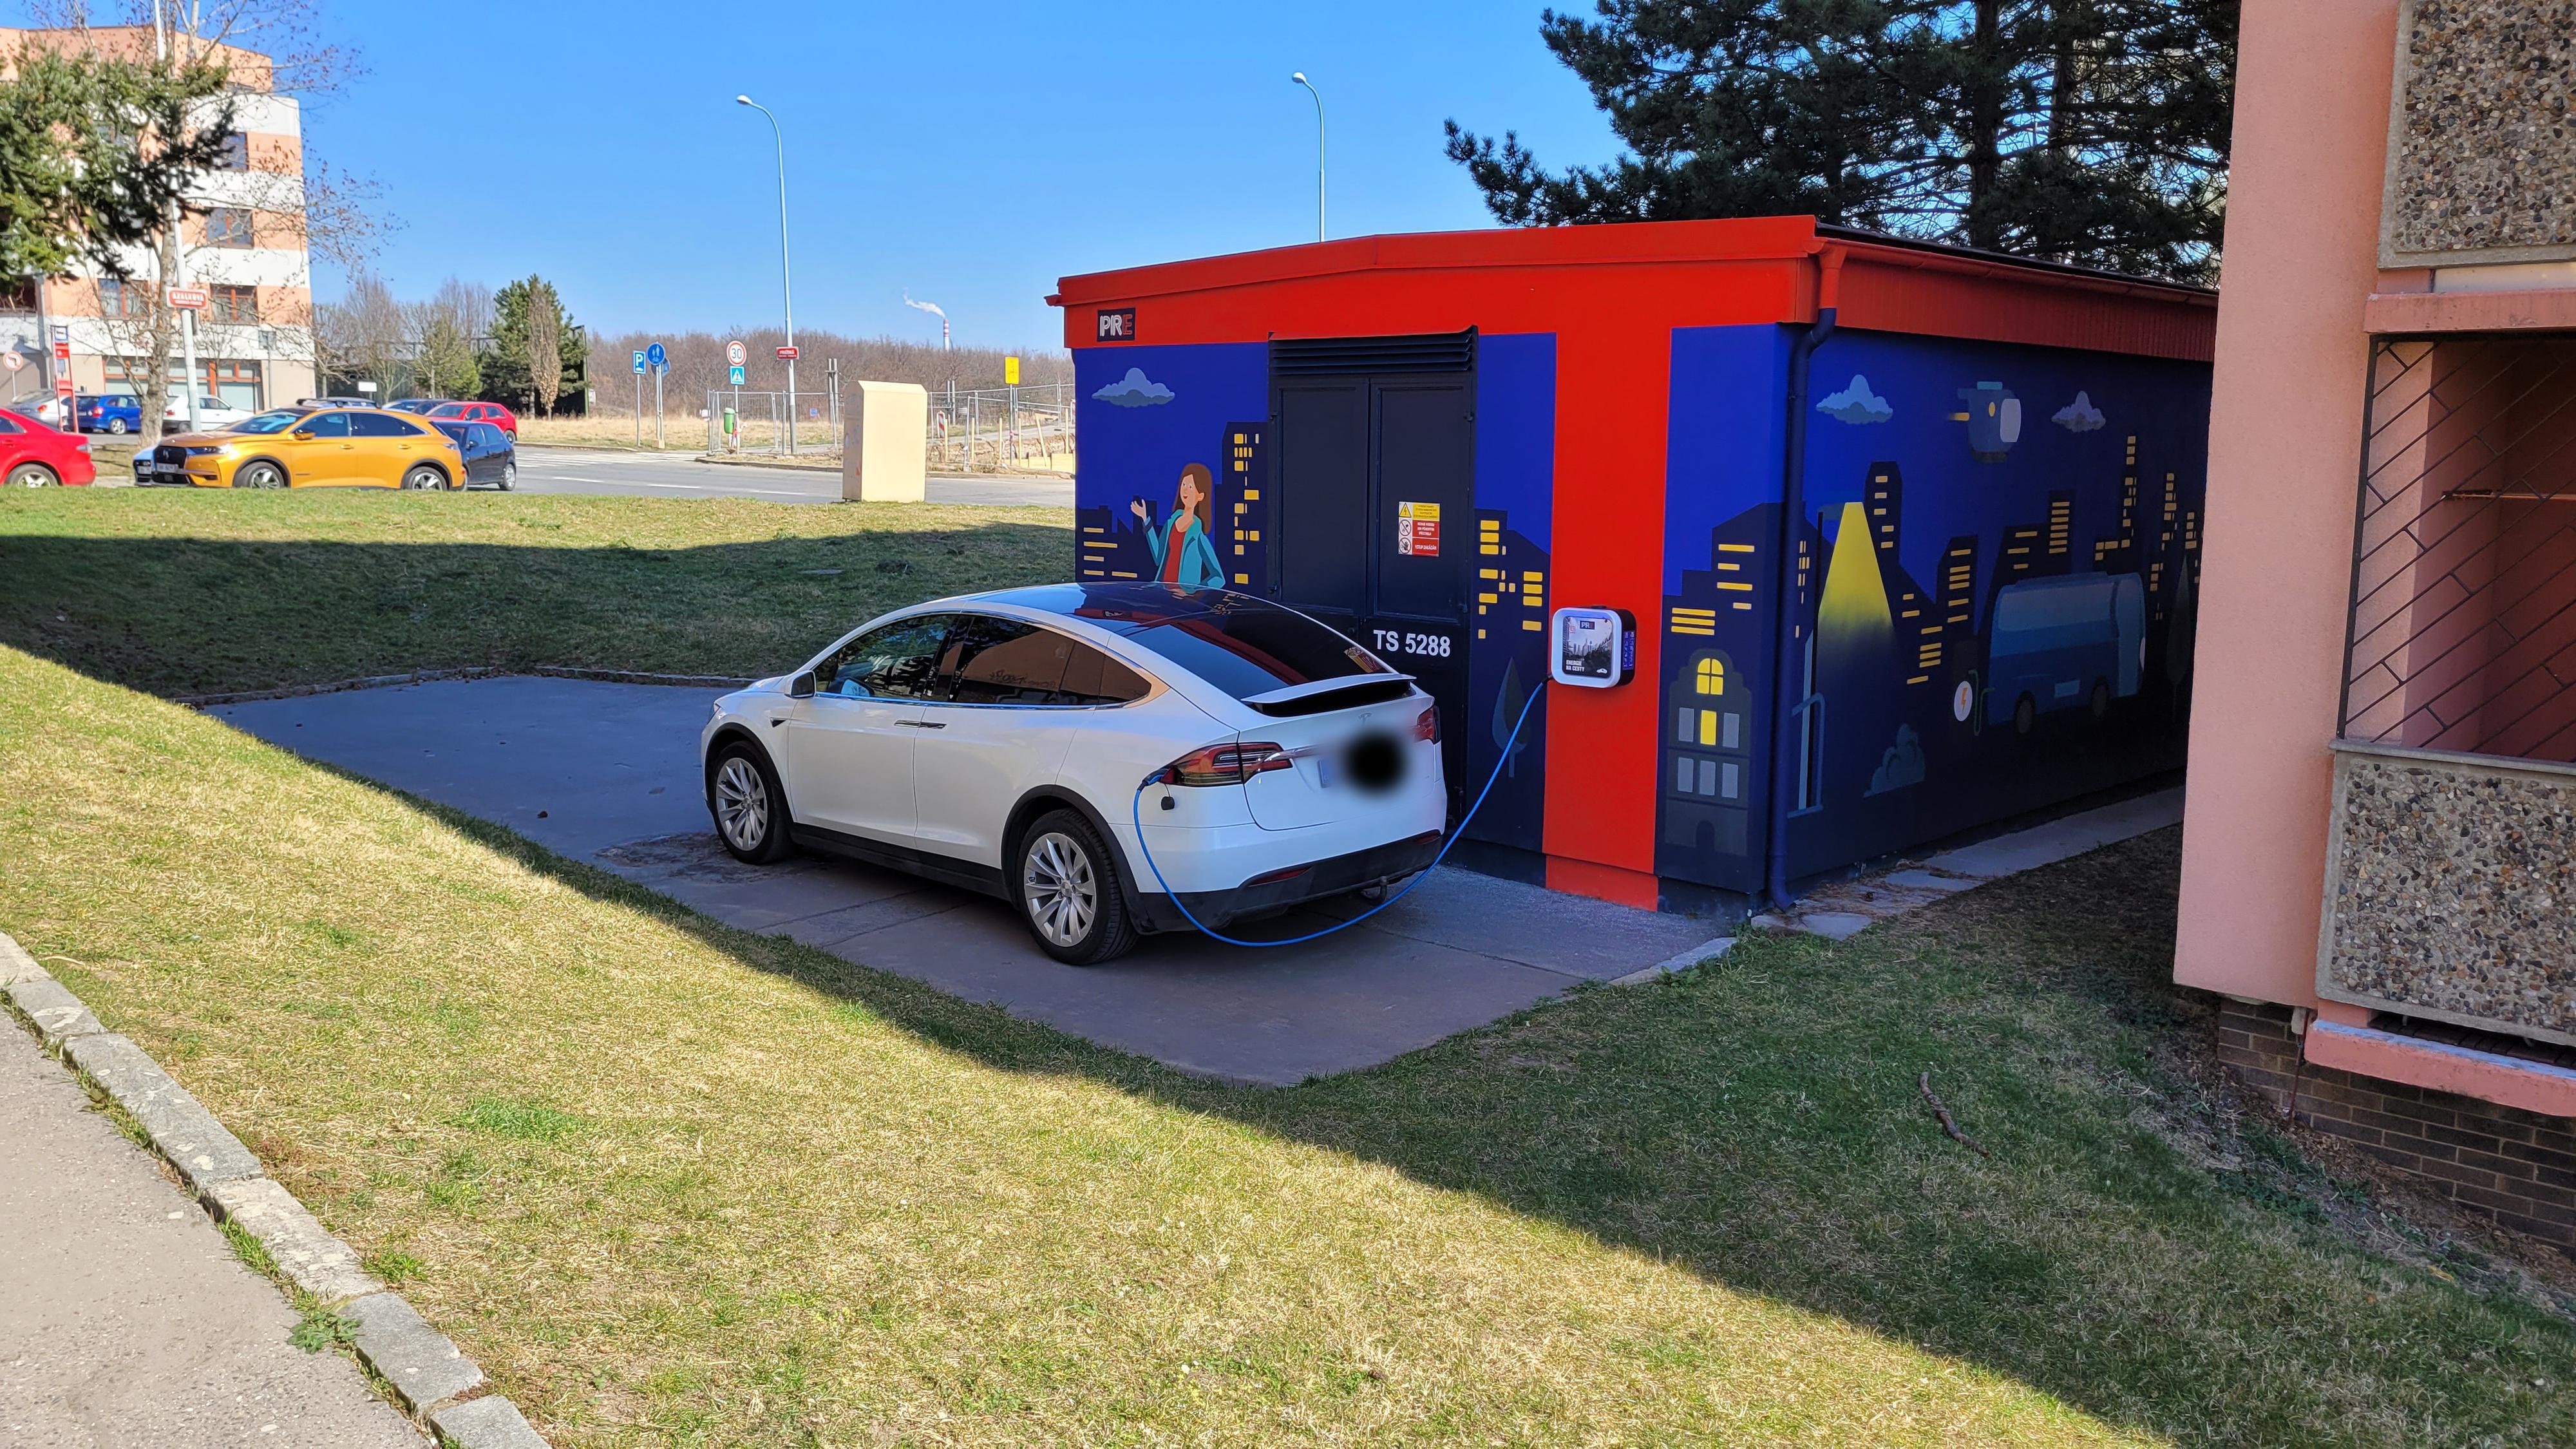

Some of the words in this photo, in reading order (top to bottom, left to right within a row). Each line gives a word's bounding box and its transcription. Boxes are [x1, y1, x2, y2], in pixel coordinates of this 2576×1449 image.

[1099, 314, 1133, 336] PRE
[636, 354, 643, 366] P
[732, 348, 743, 359] 30
[1373, 629, 1399, 652] TS
[1405, 633, 1451, 658] 5288
